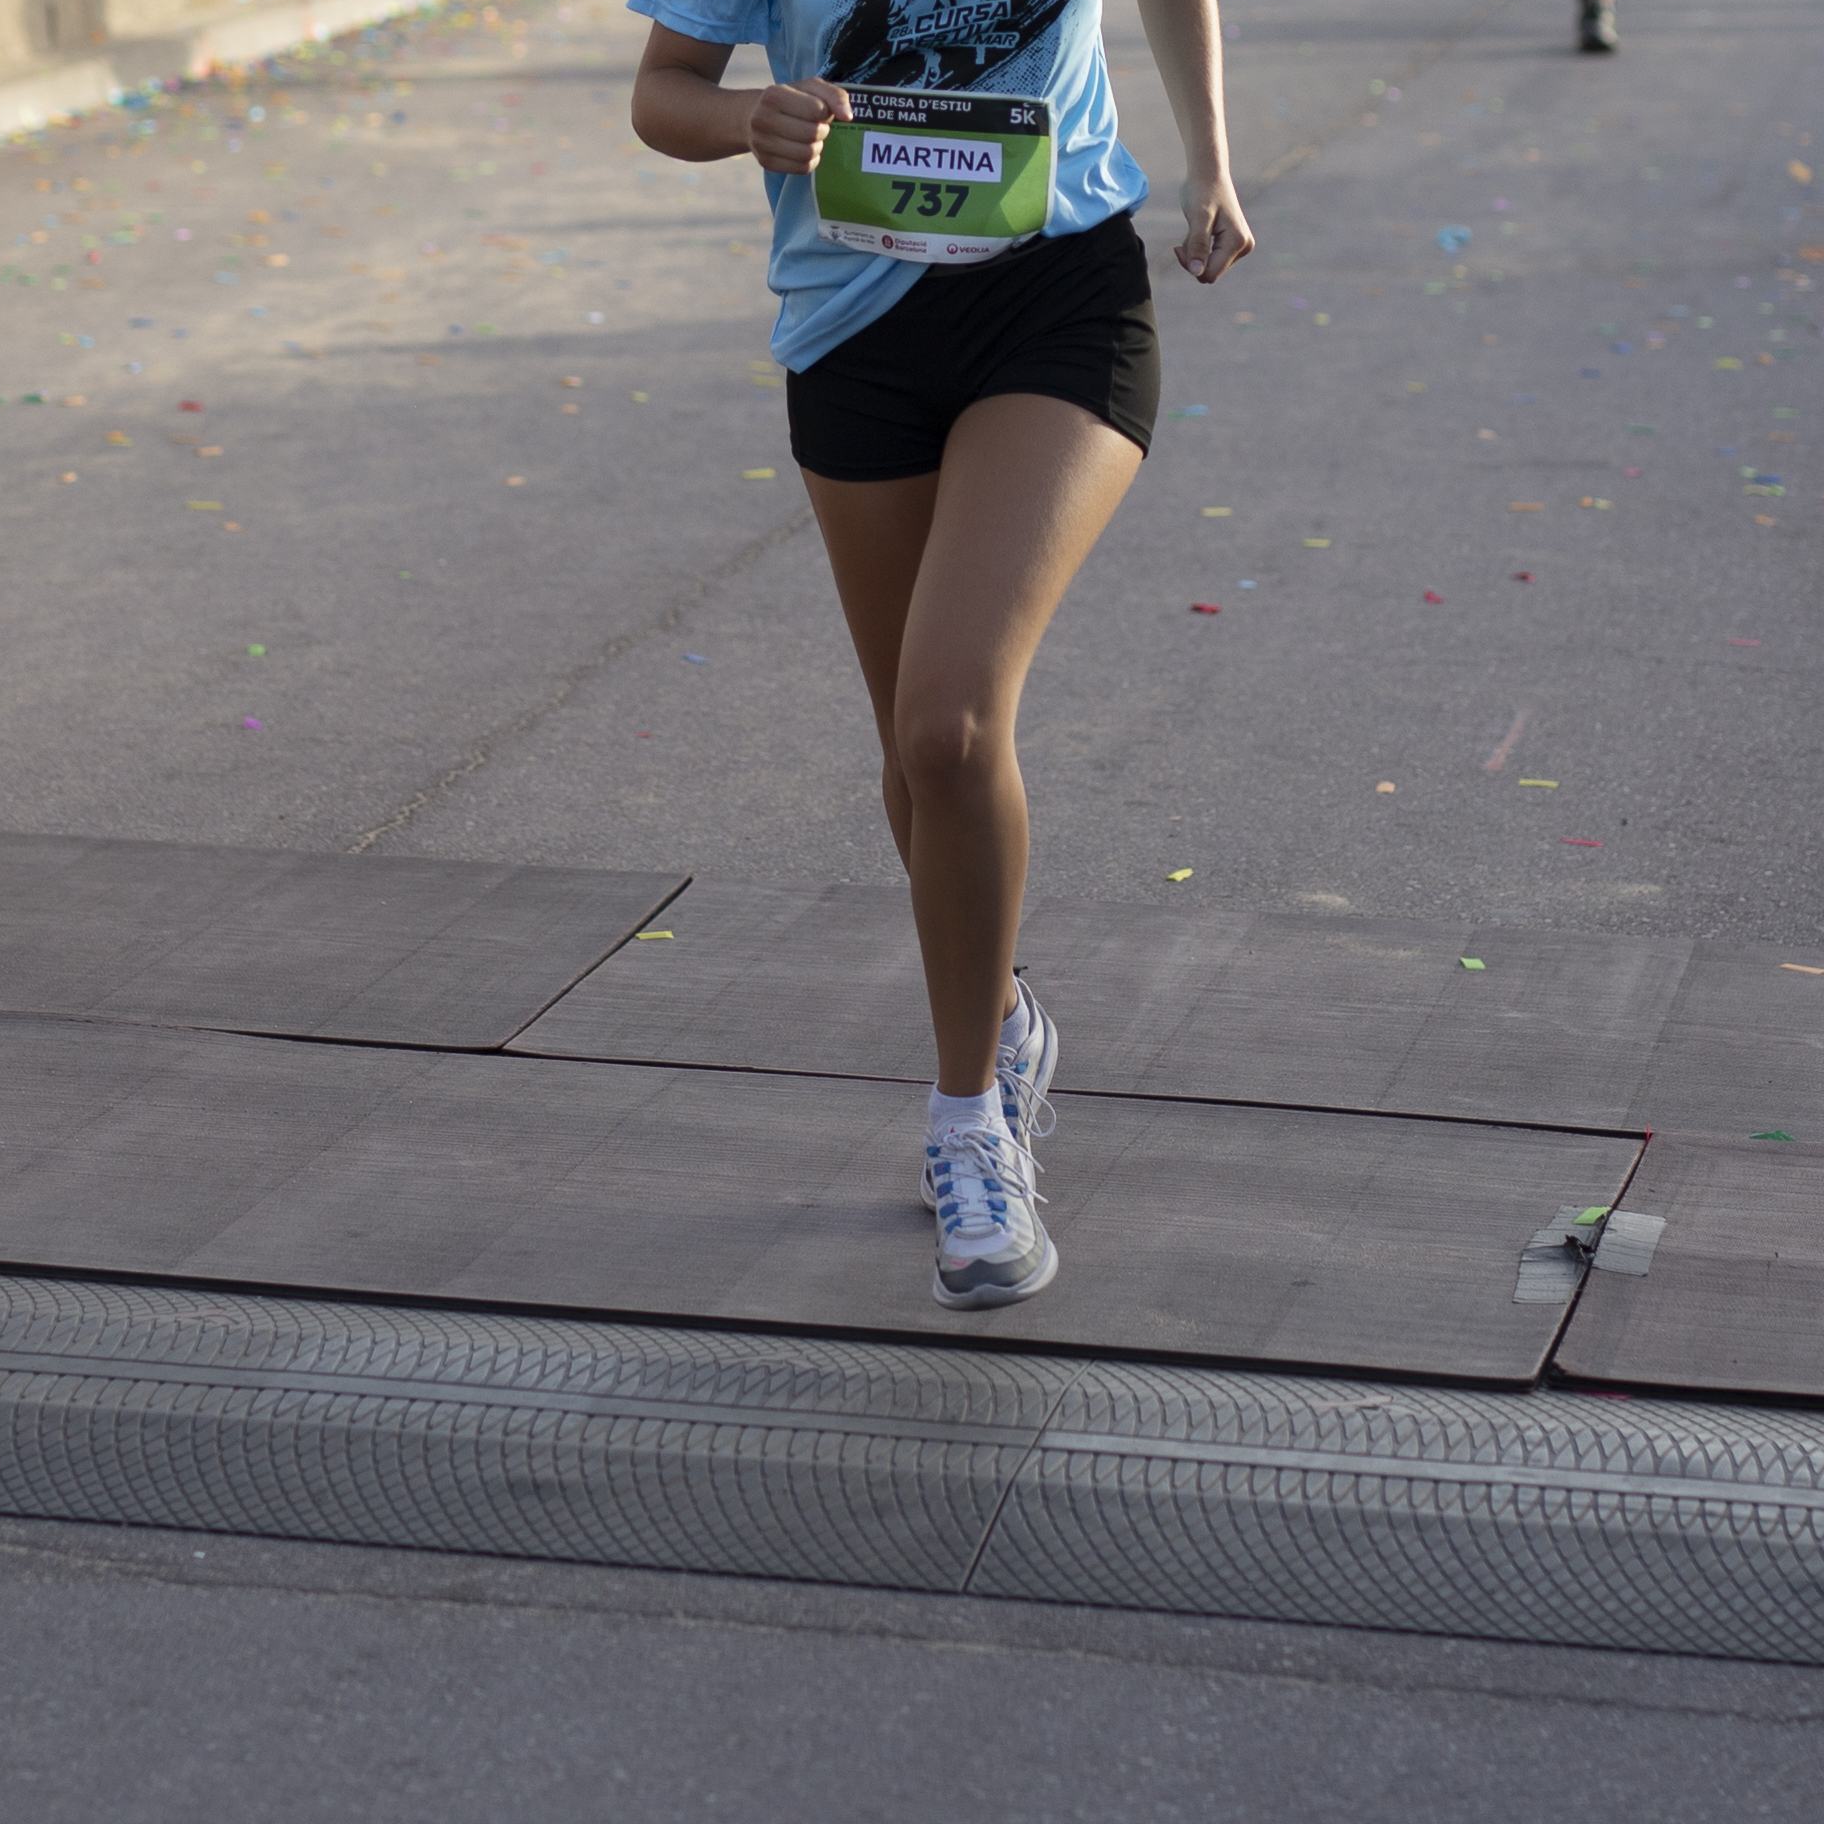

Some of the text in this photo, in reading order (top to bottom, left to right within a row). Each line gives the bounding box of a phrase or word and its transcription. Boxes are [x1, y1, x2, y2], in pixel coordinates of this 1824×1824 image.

[914, 1, 1009, 35] CURSA
[872, 95, 914, 109] CURSA
[919, 99, 971, 112] D'ESTIU
[878, 109, 894, 120] DE
[898, 111, 927, 123] MAR
[1010, 107, 1036, 125] 5K
[871, 143, 994, 173] MARTINA
[891, 180, 970, 218] 737
